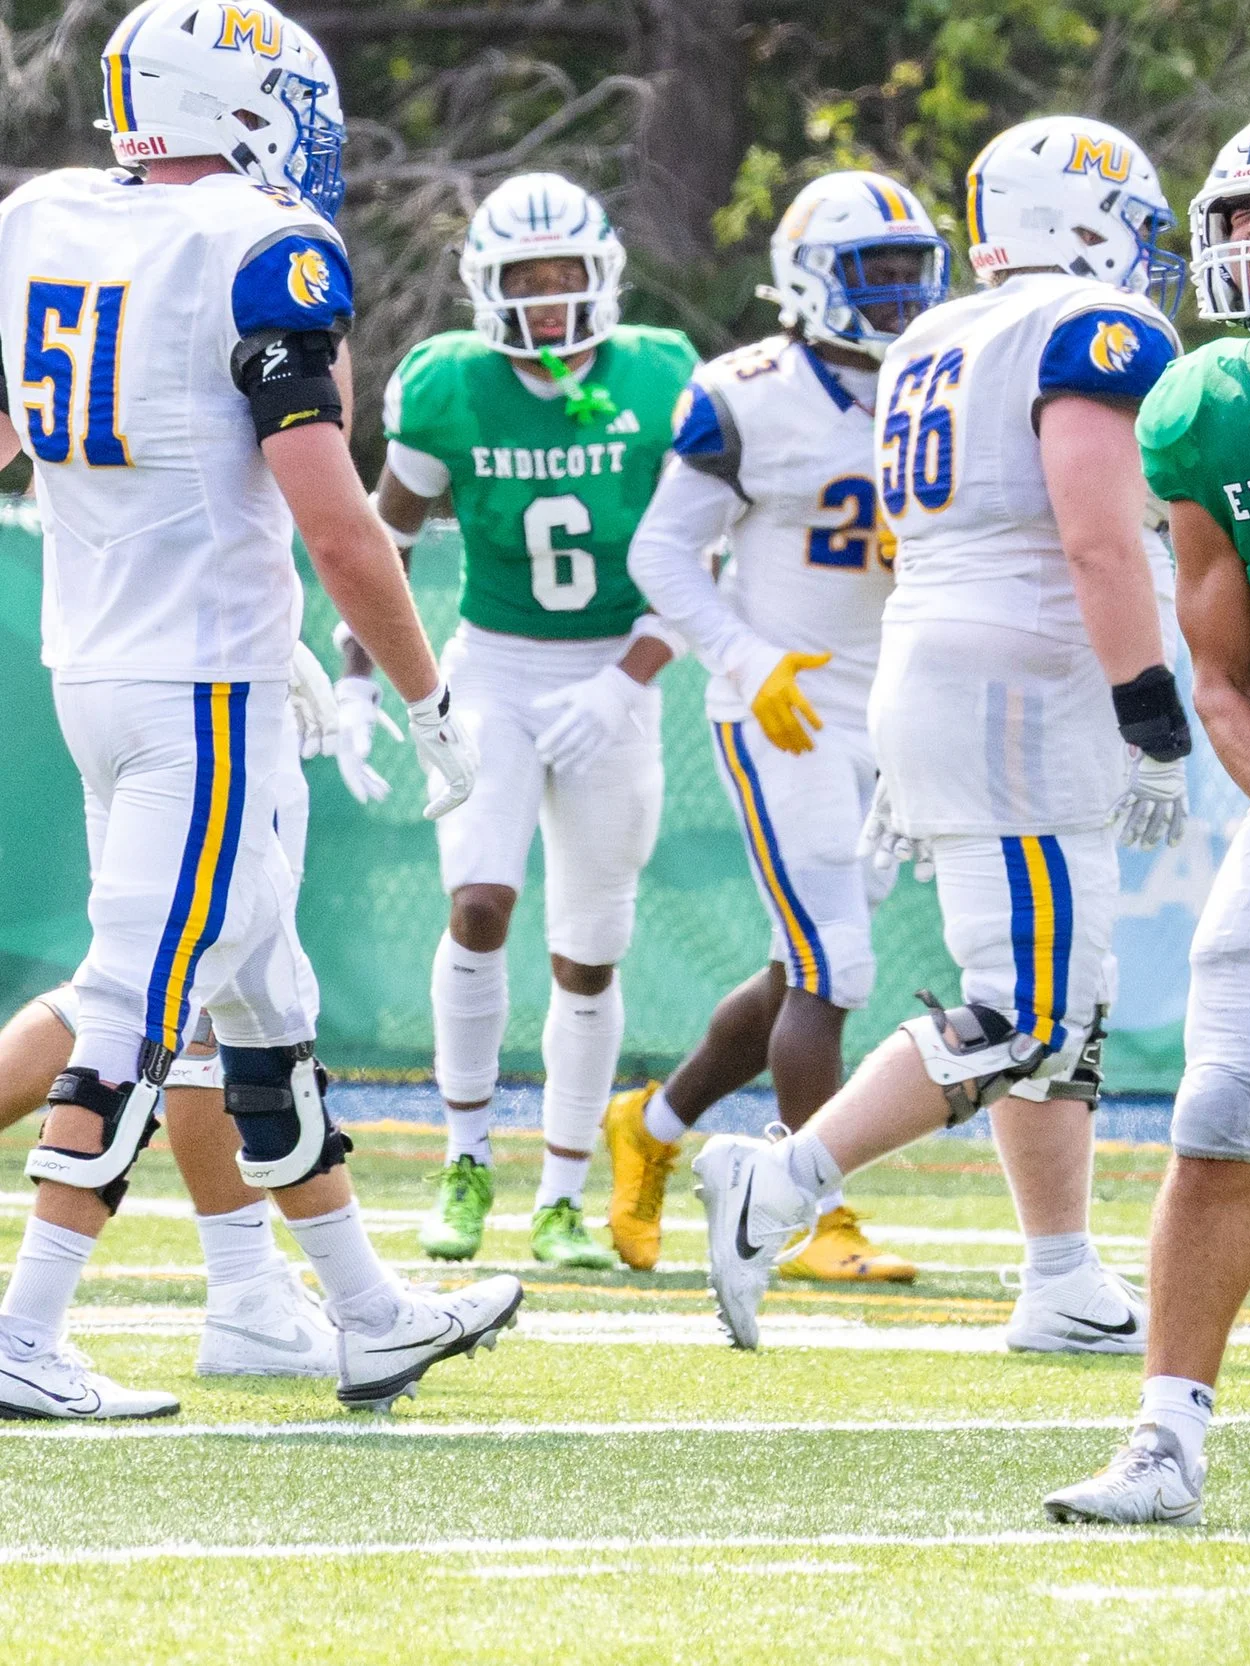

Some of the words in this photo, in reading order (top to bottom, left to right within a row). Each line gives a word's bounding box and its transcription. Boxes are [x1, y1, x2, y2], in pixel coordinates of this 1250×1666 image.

[213, 4, 284, 61] MU
[1063, 132, 1134, 184] MU
[22, 276, 135, 468] 51
[470, 441, 627, 480] ENDICOTT
[881, 347, 967, 519] 56
[523, 493, 598, 612] 6
